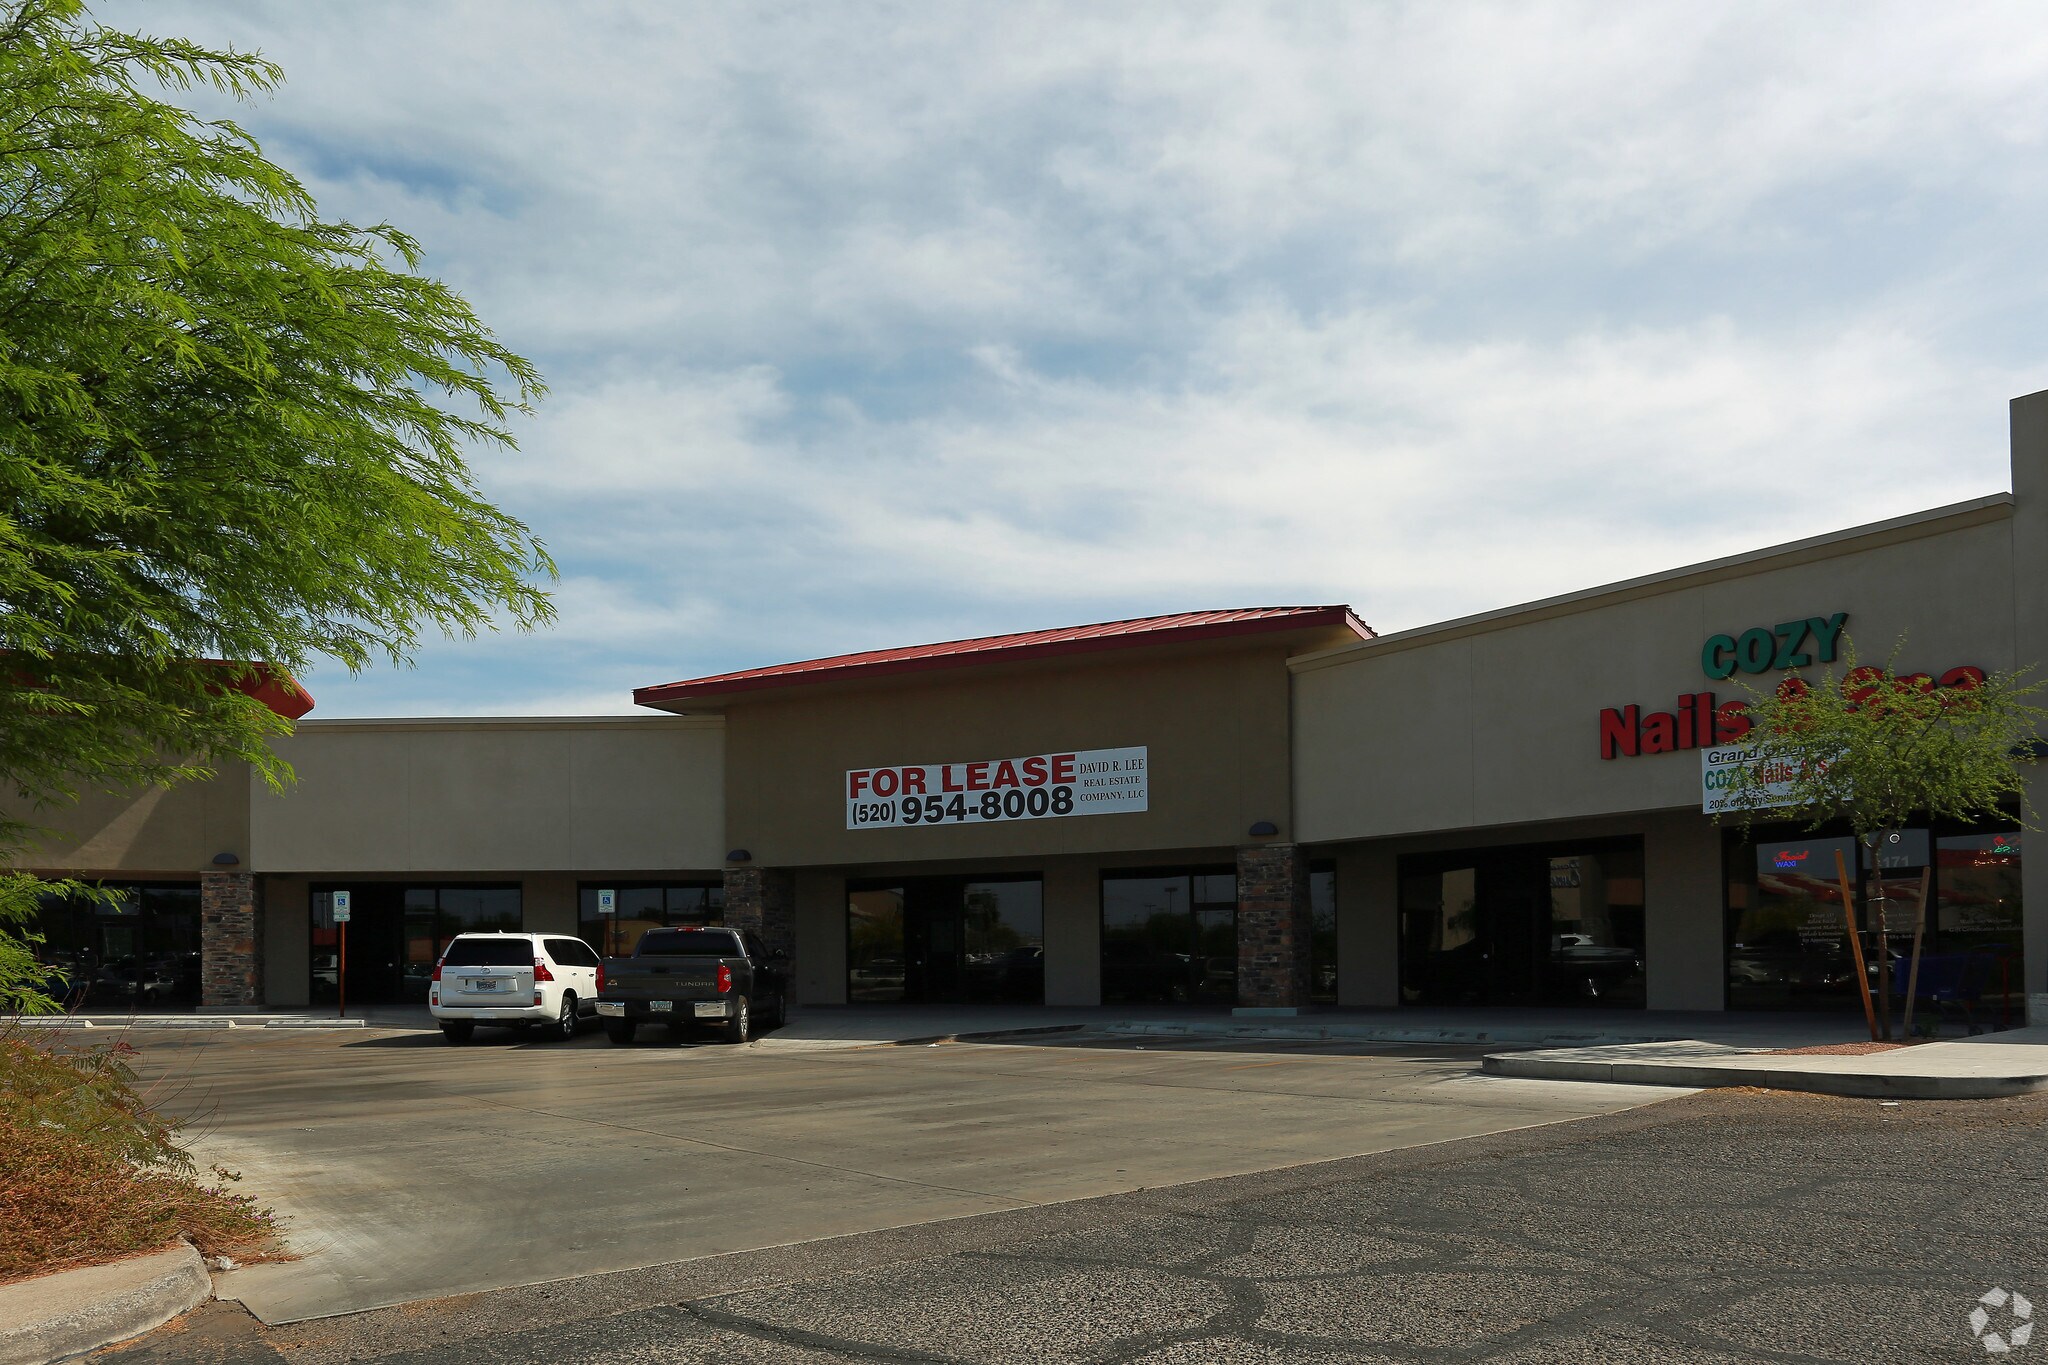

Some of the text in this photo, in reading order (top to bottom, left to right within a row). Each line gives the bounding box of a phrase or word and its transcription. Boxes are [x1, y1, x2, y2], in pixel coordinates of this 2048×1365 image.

[1702, 613, 1849, 680] COZY
[1600, 692, 1754, 760] Nails
[1708, 746, 1758, 764] Grand
[1080, 759, 1145, 774] DAVID R. LEE
[850, 754, 1077, 799] FOR LEASE
[1084, 776, 1141, 787] REAL ESTATE
[1080, 790, 1145, 802] COMPANY, LLC
[853, 786, 1074, 825] (520) 954-8008
[1882, 855, 1910, 868] 171
